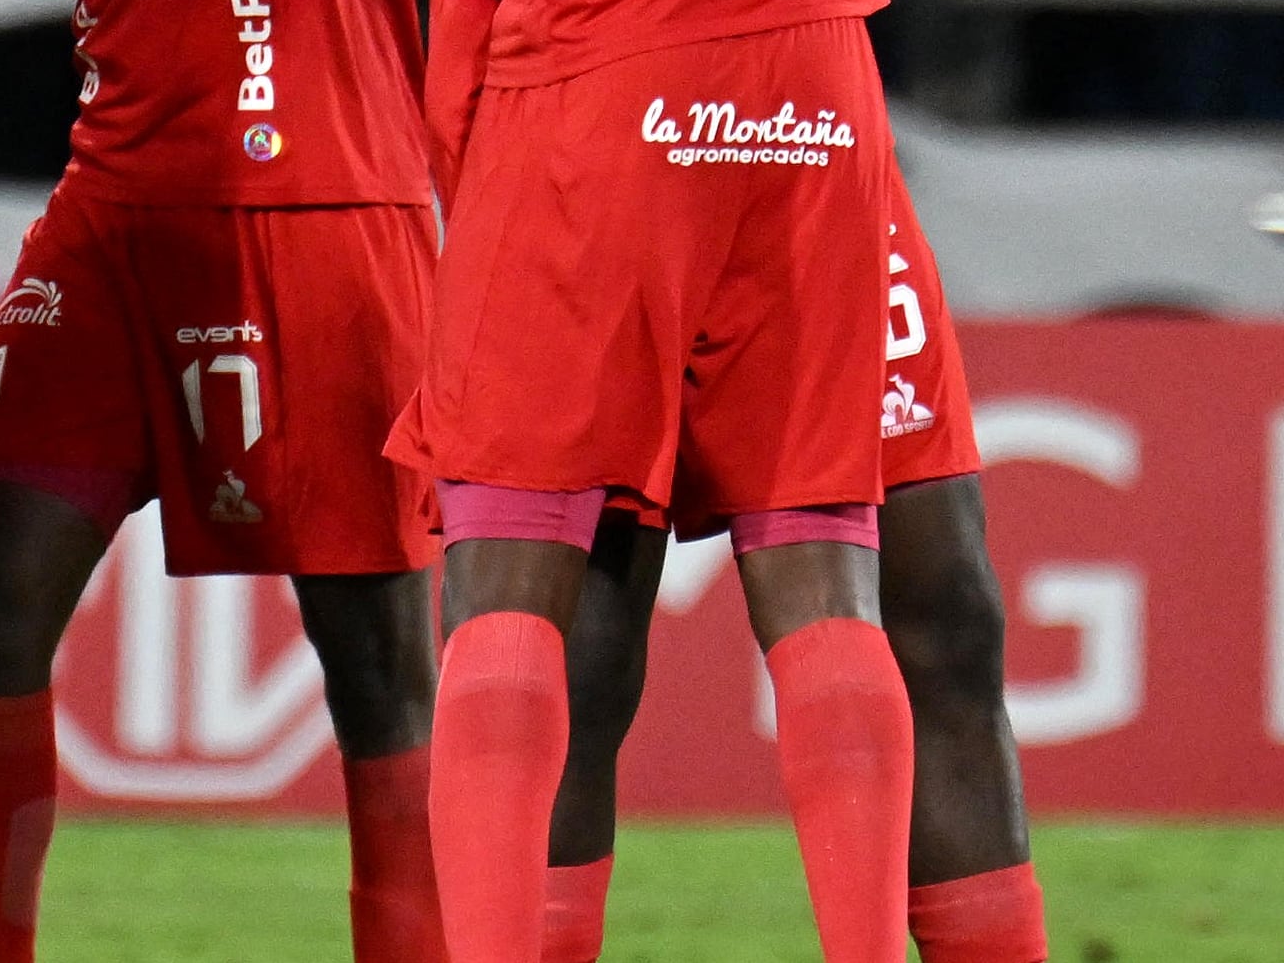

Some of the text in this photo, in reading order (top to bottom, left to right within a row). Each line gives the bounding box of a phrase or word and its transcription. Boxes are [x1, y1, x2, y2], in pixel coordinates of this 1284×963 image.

[642, 97, 855, 148] la Montaña
[667, 147, 829, 167] agromercados
[182, 354, 263, 452] 17
